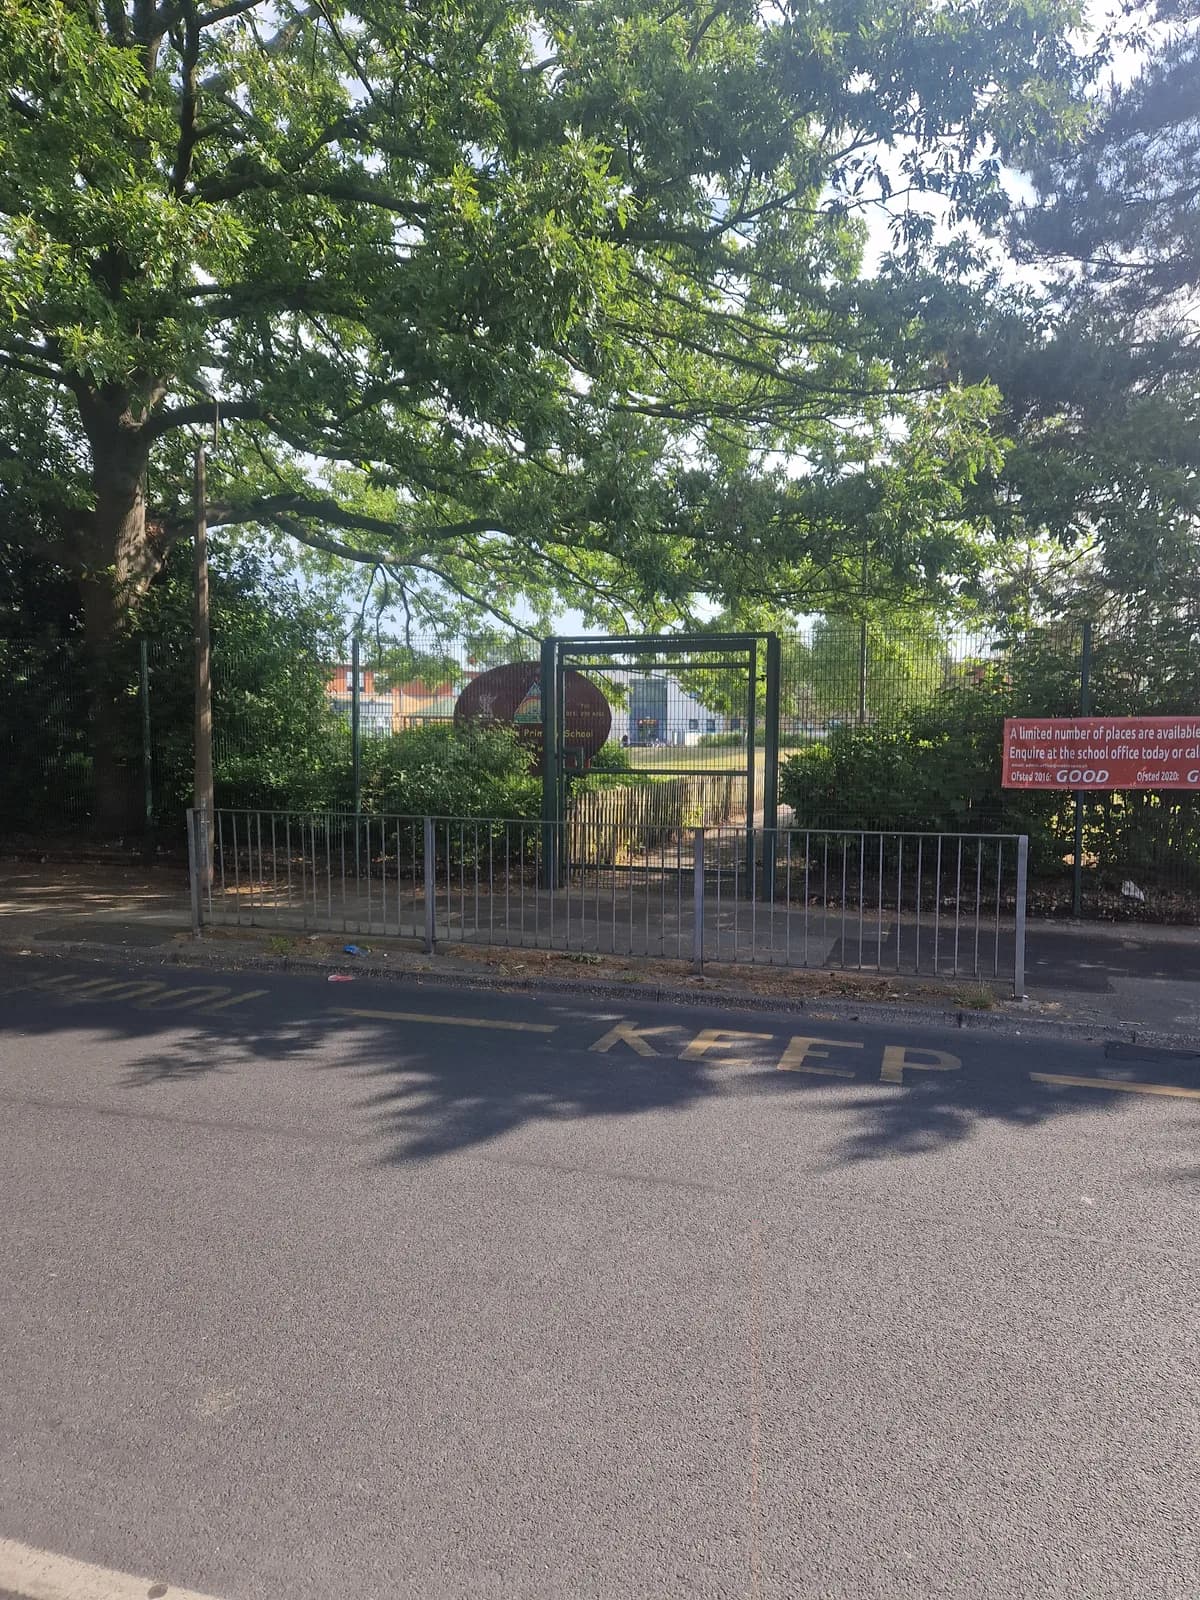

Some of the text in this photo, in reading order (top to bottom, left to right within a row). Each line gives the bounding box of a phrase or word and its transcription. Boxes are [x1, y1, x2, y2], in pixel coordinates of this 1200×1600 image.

[565, 729, 593, 738] School
[1010, 724, 1200, 742] A limited number of places are available
[1010, 744, 1200, 762] Enquire at the school office today or cal
[1011, 771, 1033, 782] Ofsted
[1056, 769, 1109, 783] GOOD
[1136, 771, 1160, 782] Ofsted
[1161, 771, 1179, 782] 2020:
[587, 1020, 962, 1084] KEEP
